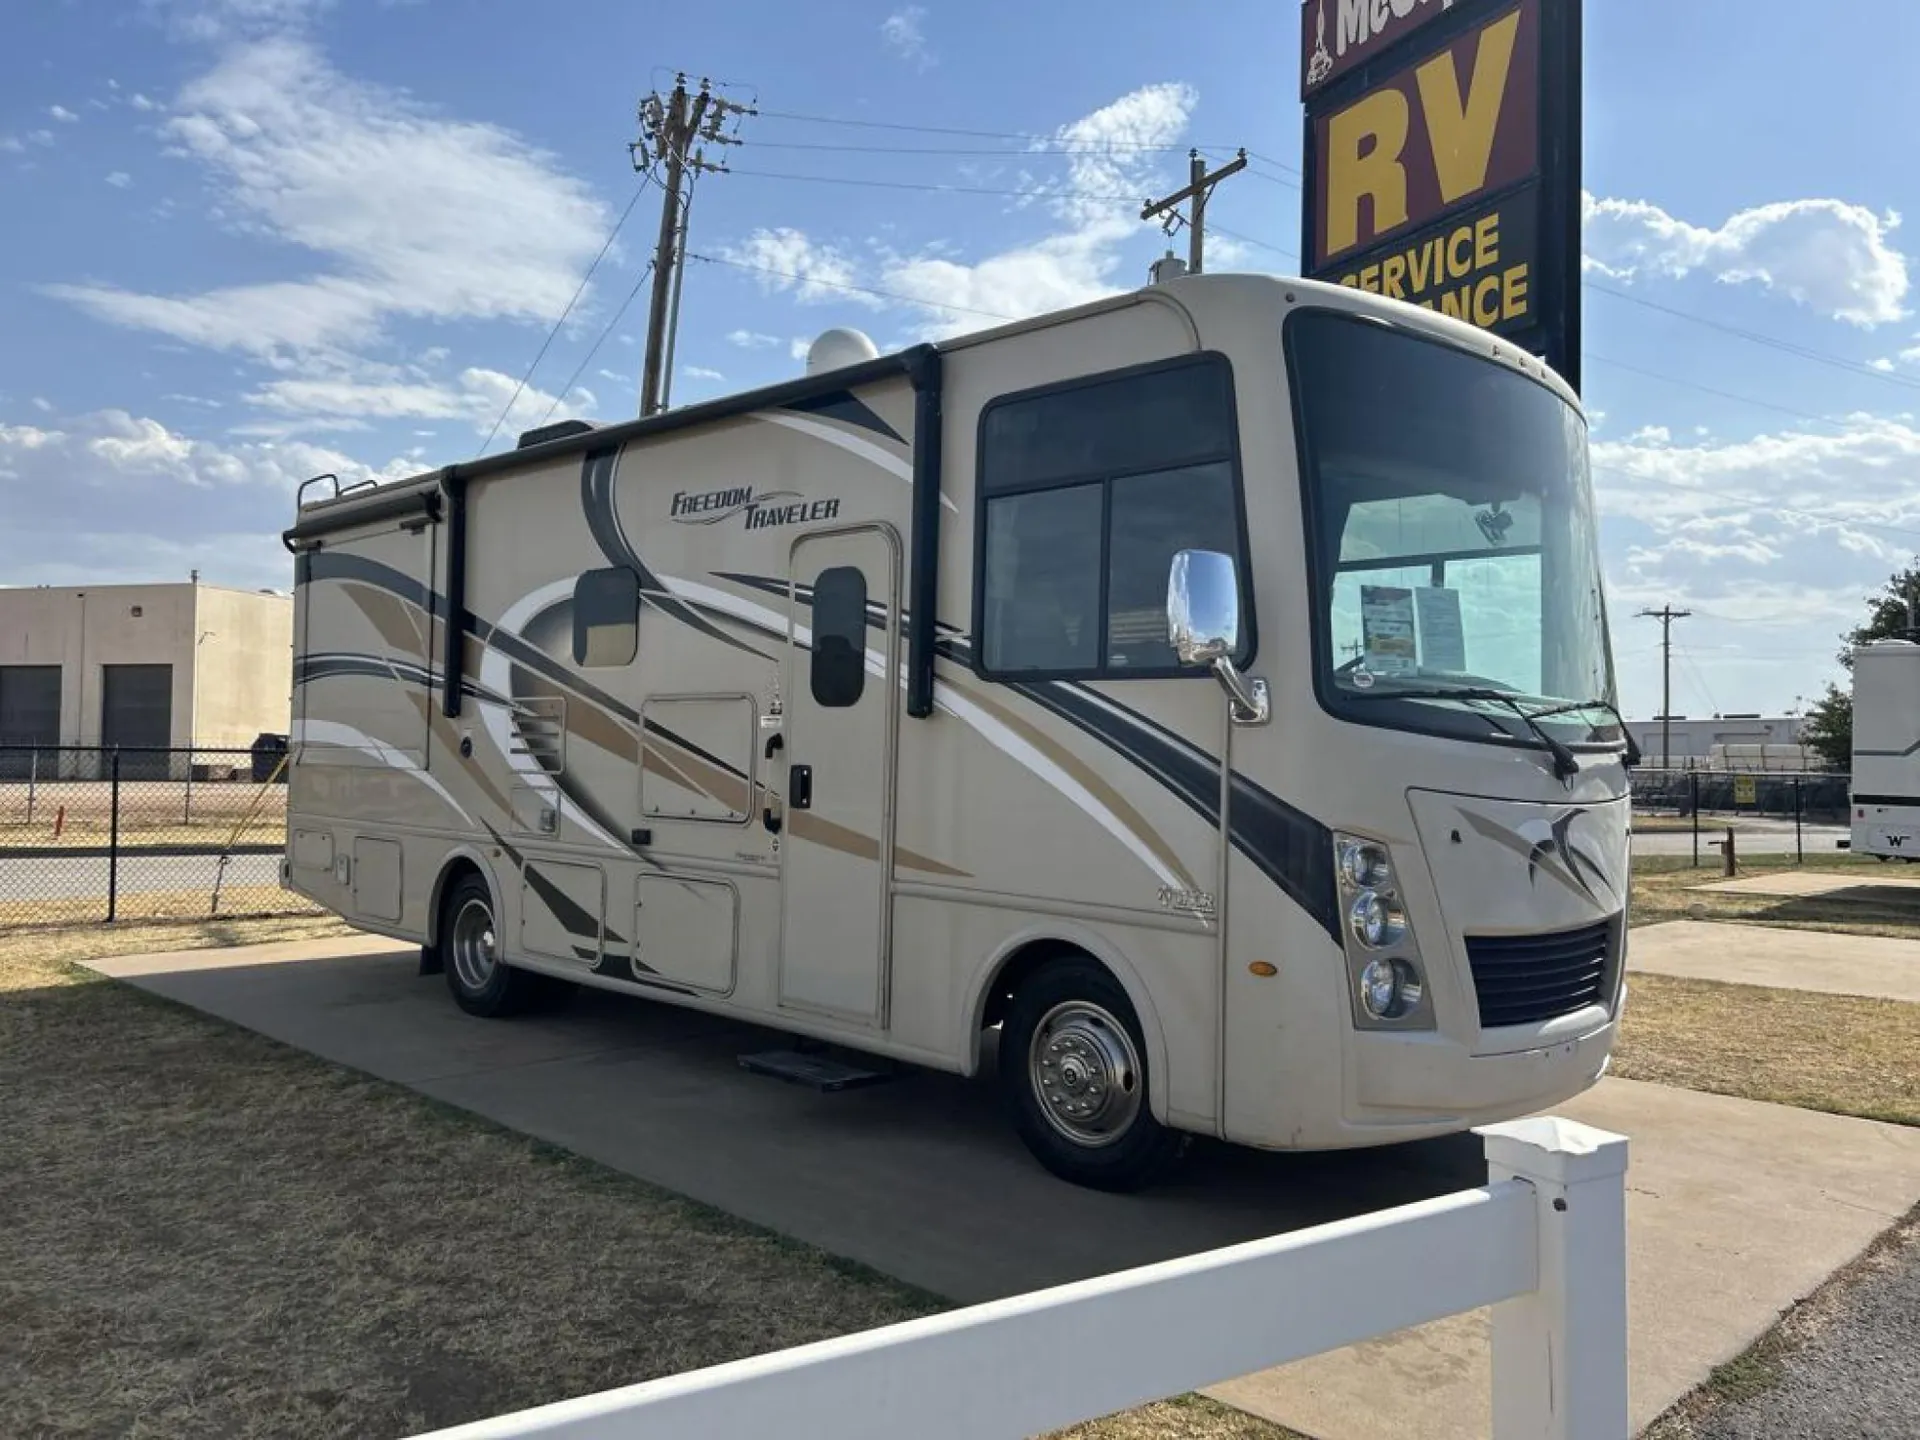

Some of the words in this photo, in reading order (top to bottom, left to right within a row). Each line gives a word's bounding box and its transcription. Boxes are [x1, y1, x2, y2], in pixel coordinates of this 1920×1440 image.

[1327, 9, 1520, 256] RV
[1419, 263, 1528, 328] NCE
[670, 485, 753, 517] FREEDOM
[744, 498, 840, 530] TRAVELER
